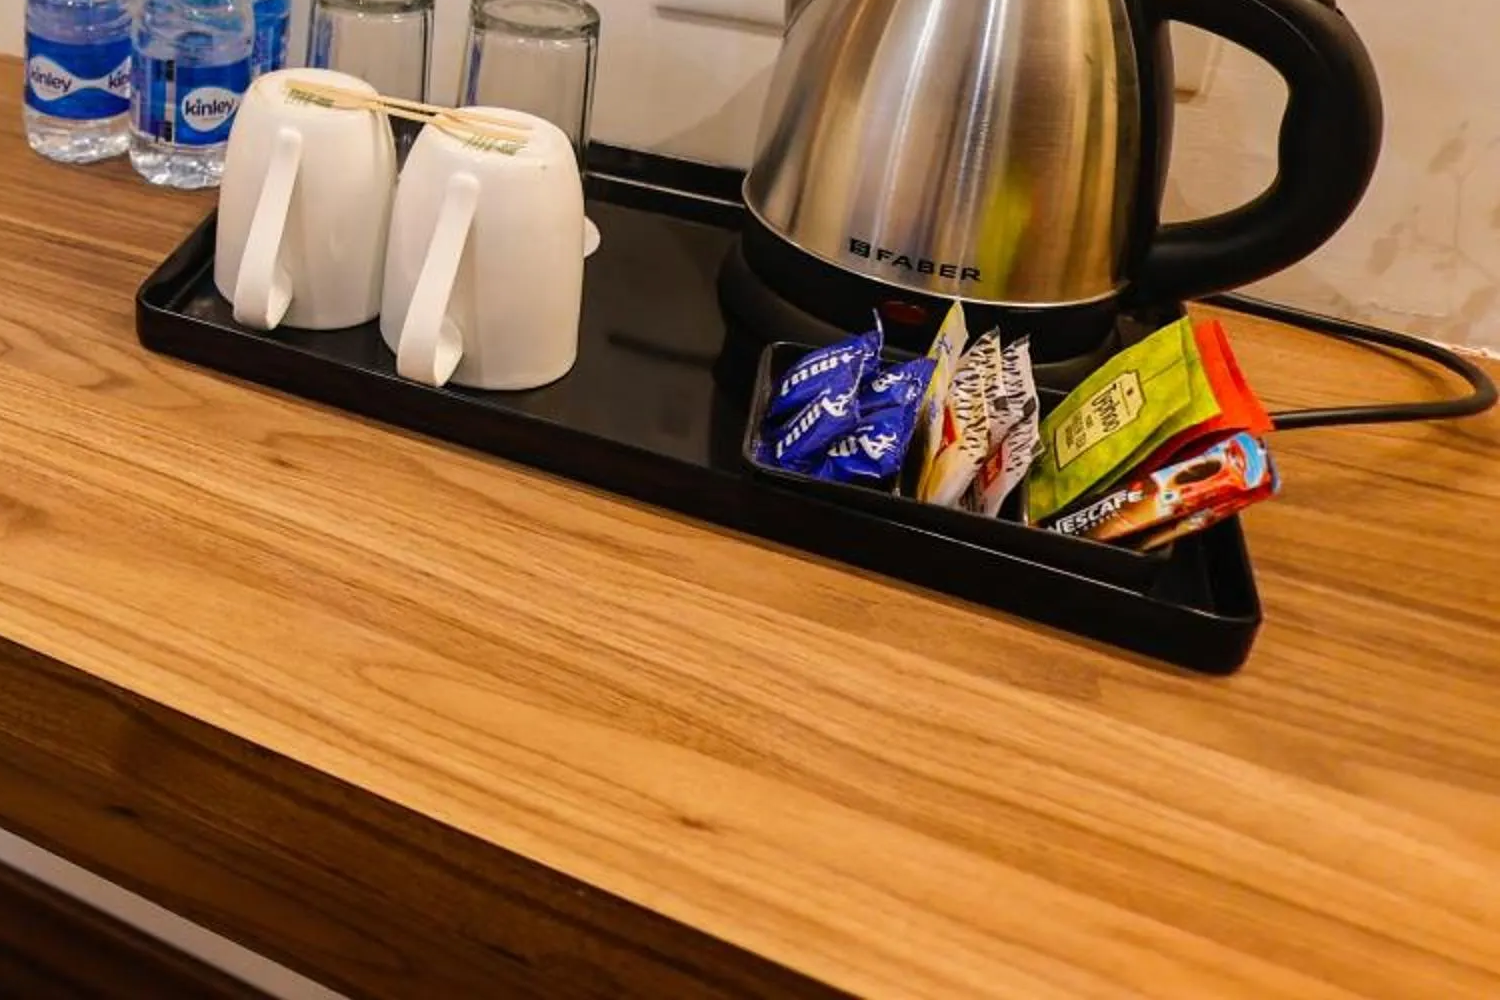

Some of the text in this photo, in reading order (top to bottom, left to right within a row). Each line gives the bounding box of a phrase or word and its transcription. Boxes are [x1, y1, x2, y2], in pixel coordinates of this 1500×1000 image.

[31, 68, 72, 93] kinley
[185, 98, 234, 117] kinley
[876, 249, 982, 281] FABER
